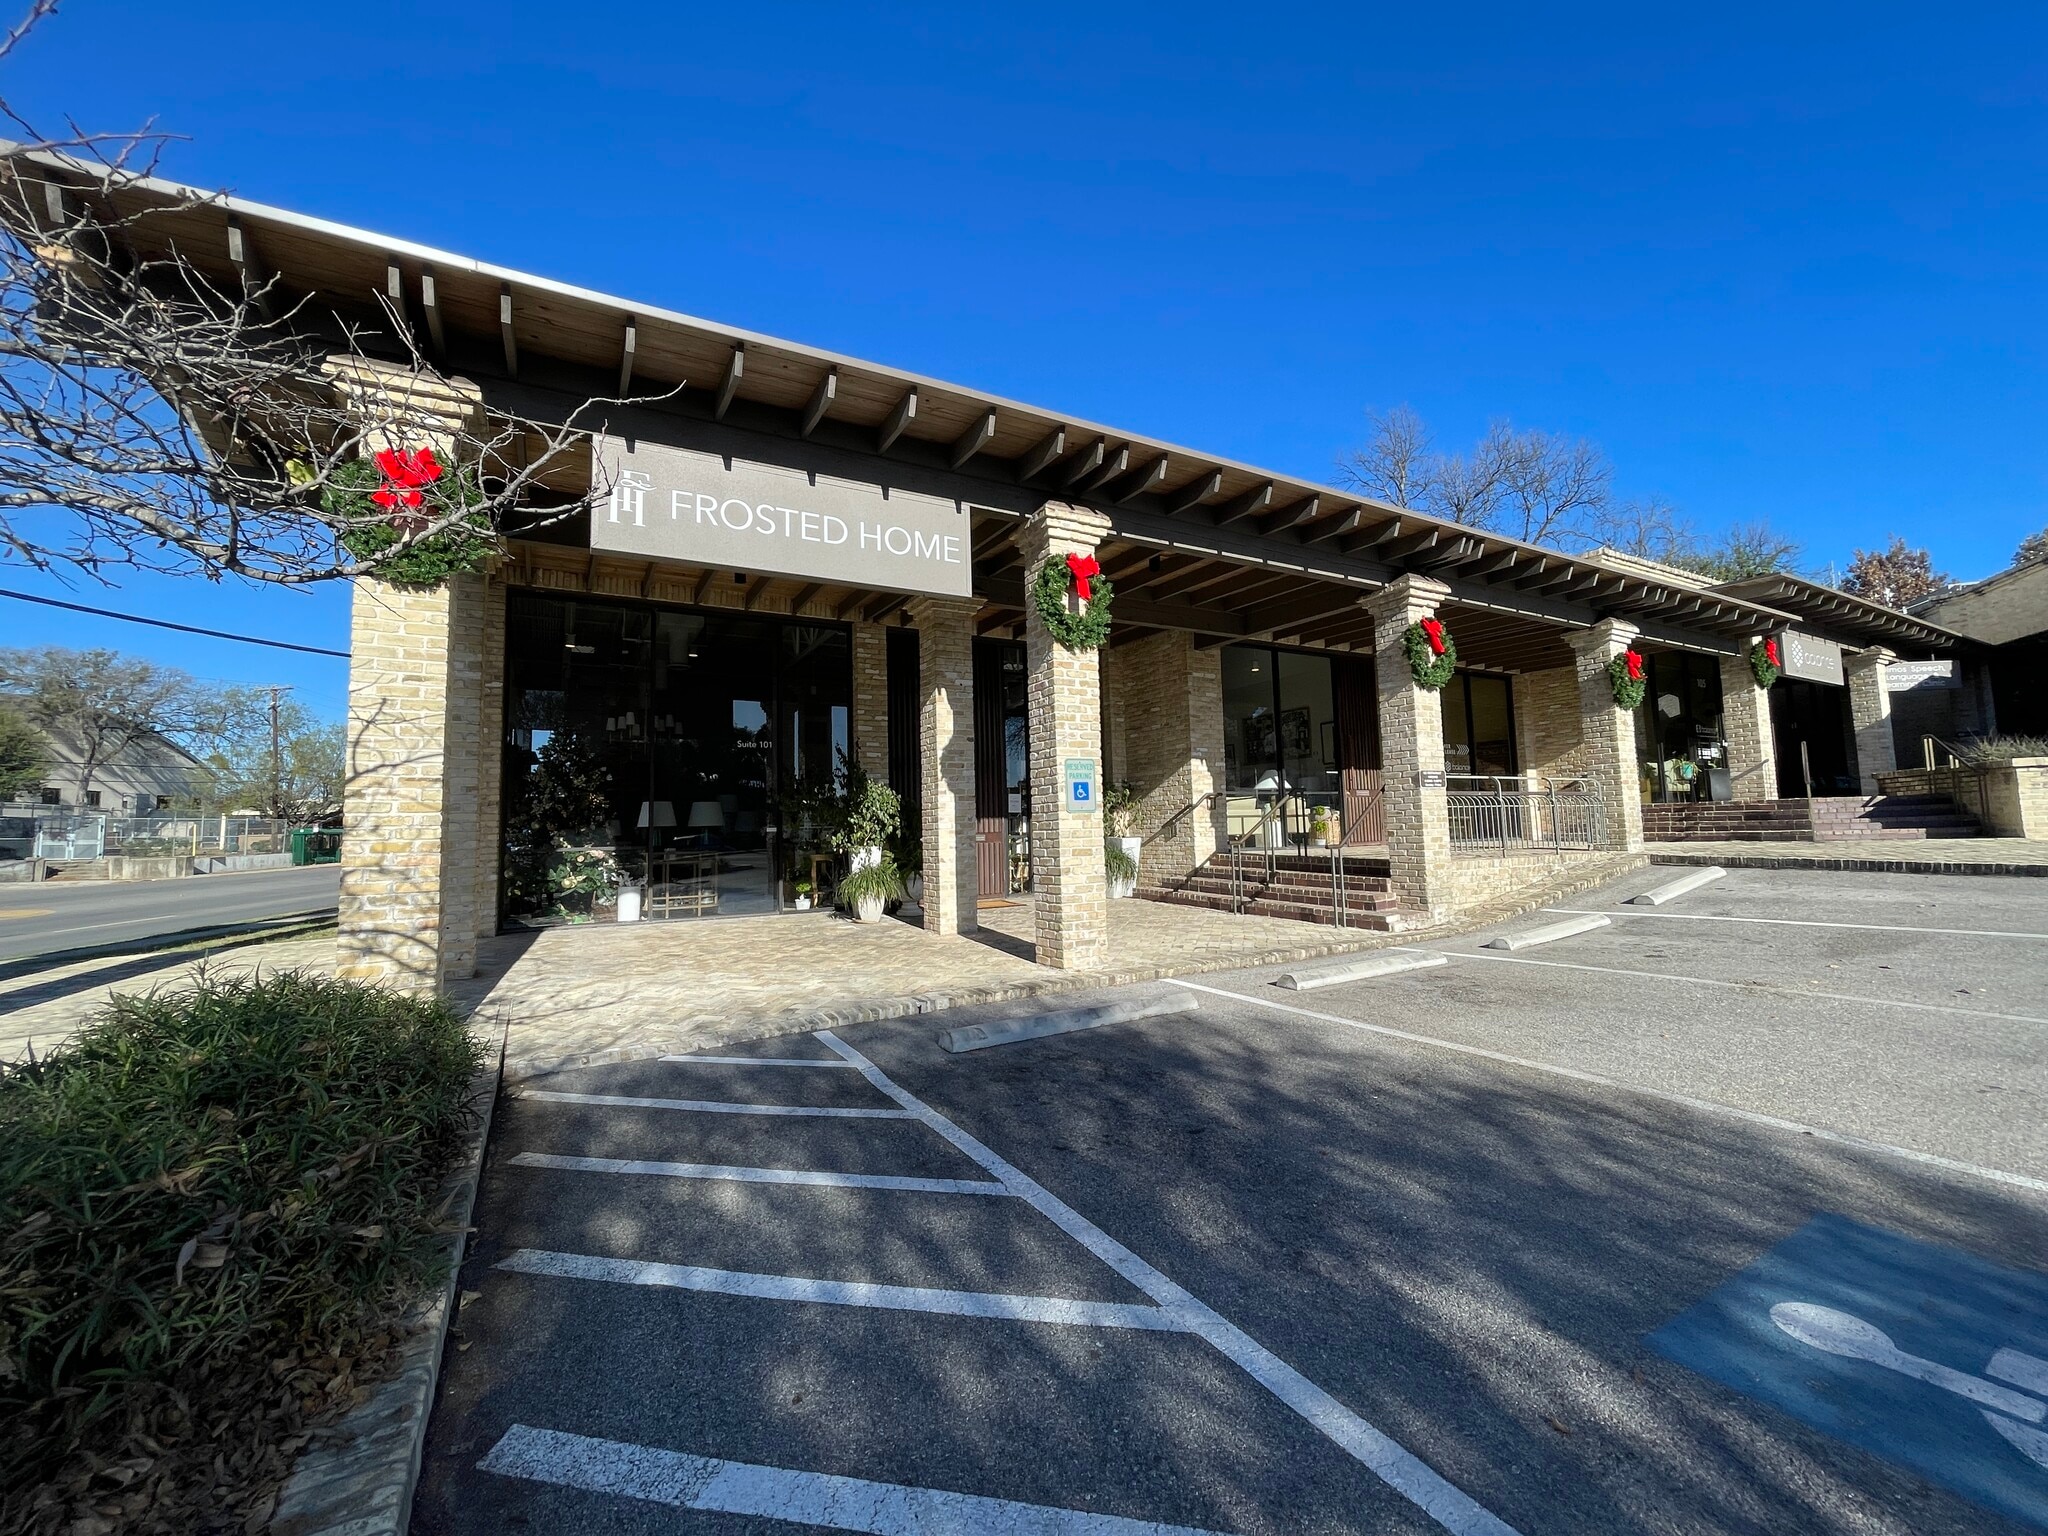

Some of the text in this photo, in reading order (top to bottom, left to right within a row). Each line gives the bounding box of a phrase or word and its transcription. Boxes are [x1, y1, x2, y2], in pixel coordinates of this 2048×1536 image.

[670, 489, 962, 563] FROSTED HOME
[737, 740, 757, 748] Suite
[1066, 763, 1093, 771] RESERVED
[1068, 772, 1092, 780] PARKING
